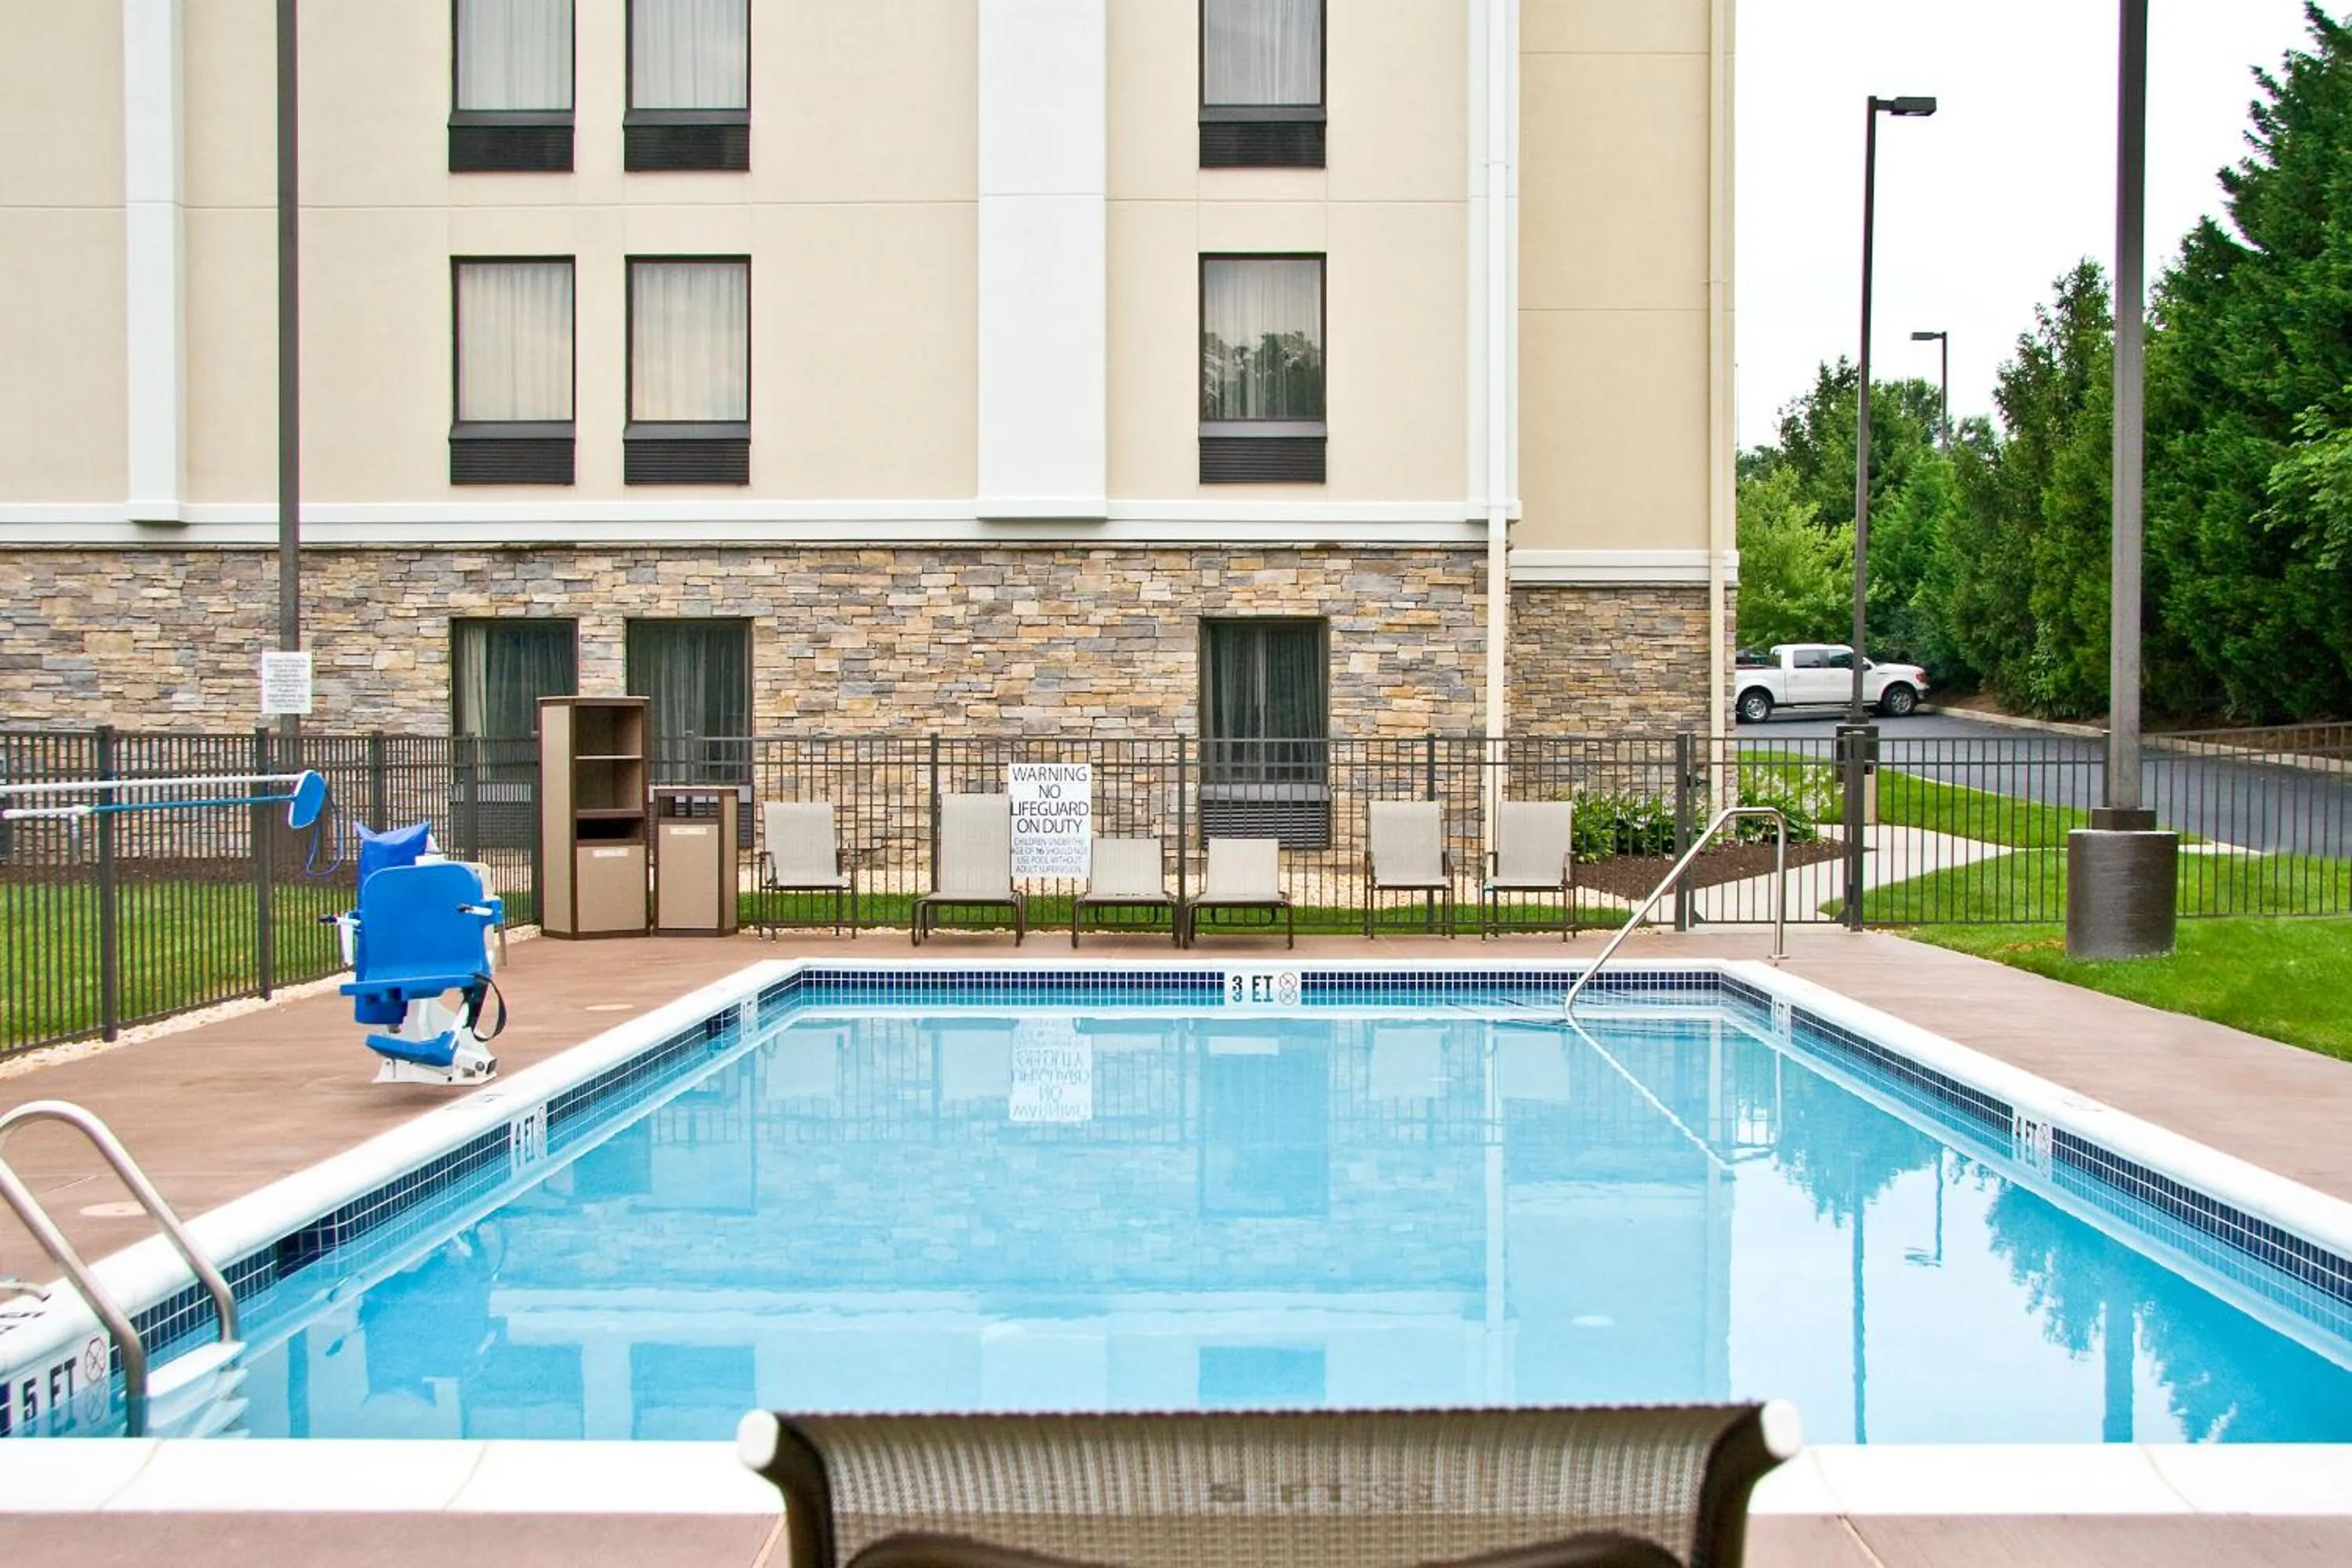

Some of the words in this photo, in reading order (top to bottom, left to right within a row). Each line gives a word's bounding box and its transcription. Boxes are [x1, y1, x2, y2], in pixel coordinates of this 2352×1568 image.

[1012, 766, 1087, 782] WARNING
[1039, 785, 1061, 799] NO
[1011, 800, 1089, 816] LIFEGUARD
[1017, 818, 1040, 833] ON
[1042, 818, 1083, 833] DUTY
[1232, 975, 1243, 991] 3
[23, 1377, 38, 1421] 5
[49, 1356, 77, 1407] FT
